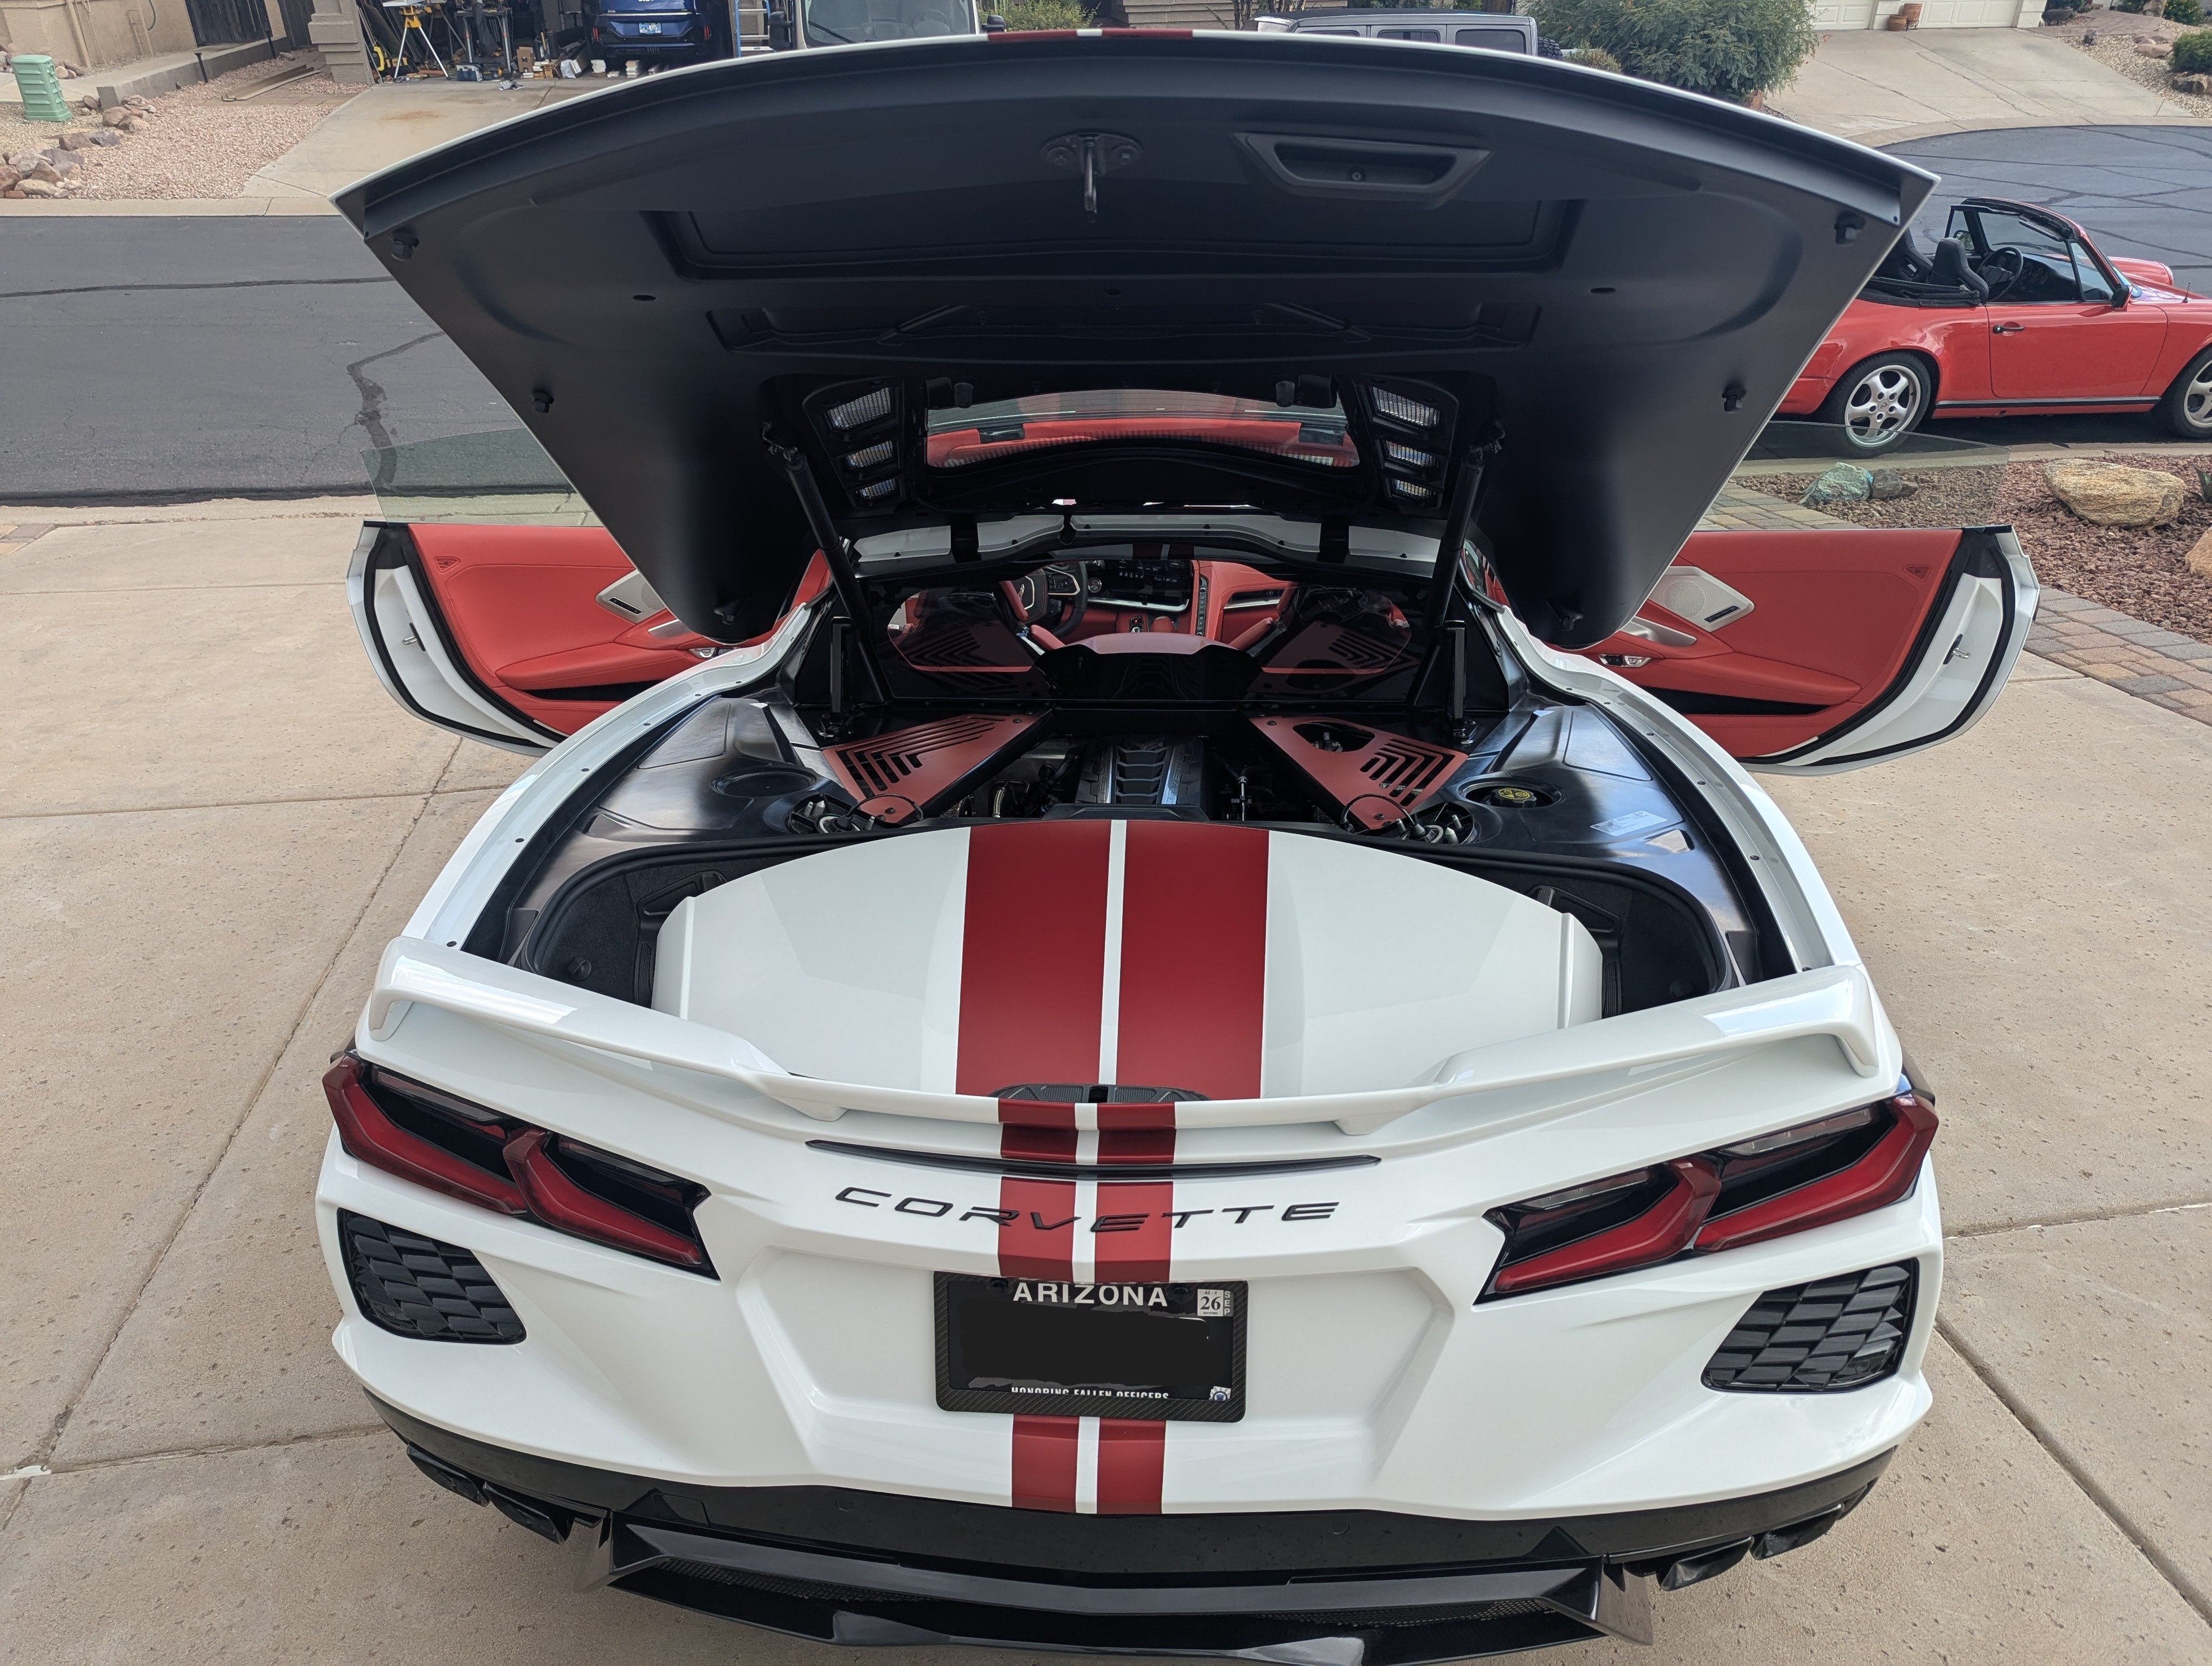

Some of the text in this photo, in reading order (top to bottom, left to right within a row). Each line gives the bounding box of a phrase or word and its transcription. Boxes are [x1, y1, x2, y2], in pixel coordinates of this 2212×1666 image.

[835, 1186, 1340, 1233] CORVETTE
[1013, 1282, 1168, 1306] ARIZONA
[1200, 1296, 1221, 1310] 26
